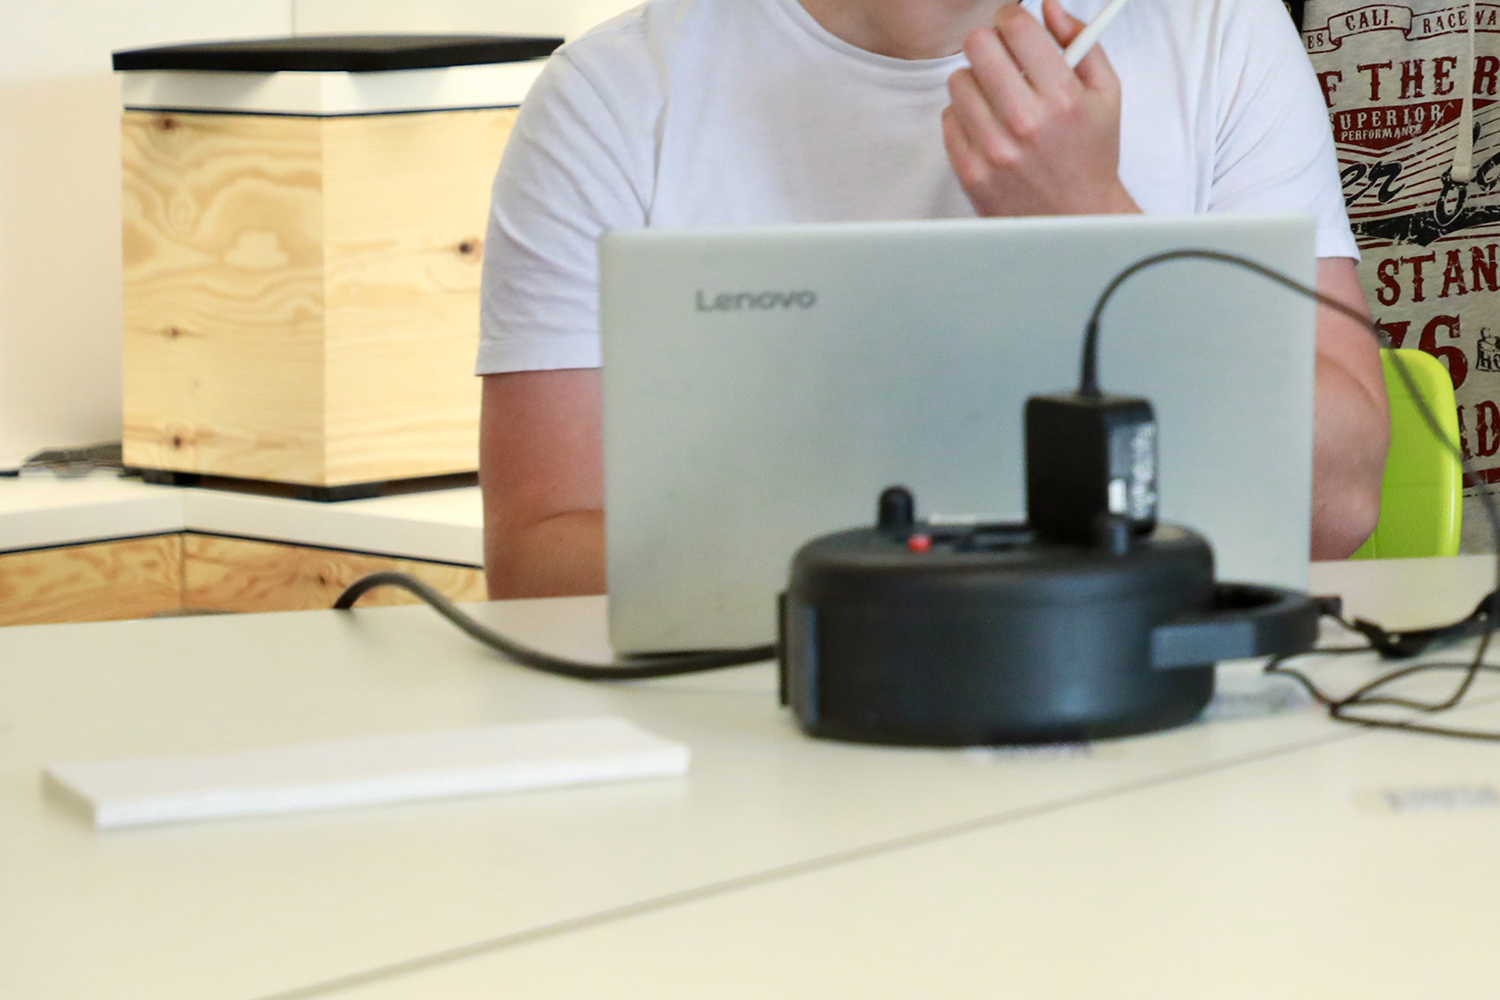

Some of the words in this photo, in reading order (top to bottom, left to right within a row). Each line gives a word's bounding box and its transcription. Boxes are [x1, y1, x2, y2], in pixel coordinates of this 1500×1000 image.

[1344, 9, 1394, 32] CALI.
[1356, 55, 1458, 102] THE
[695, 289, 818, 312] Lenovo
